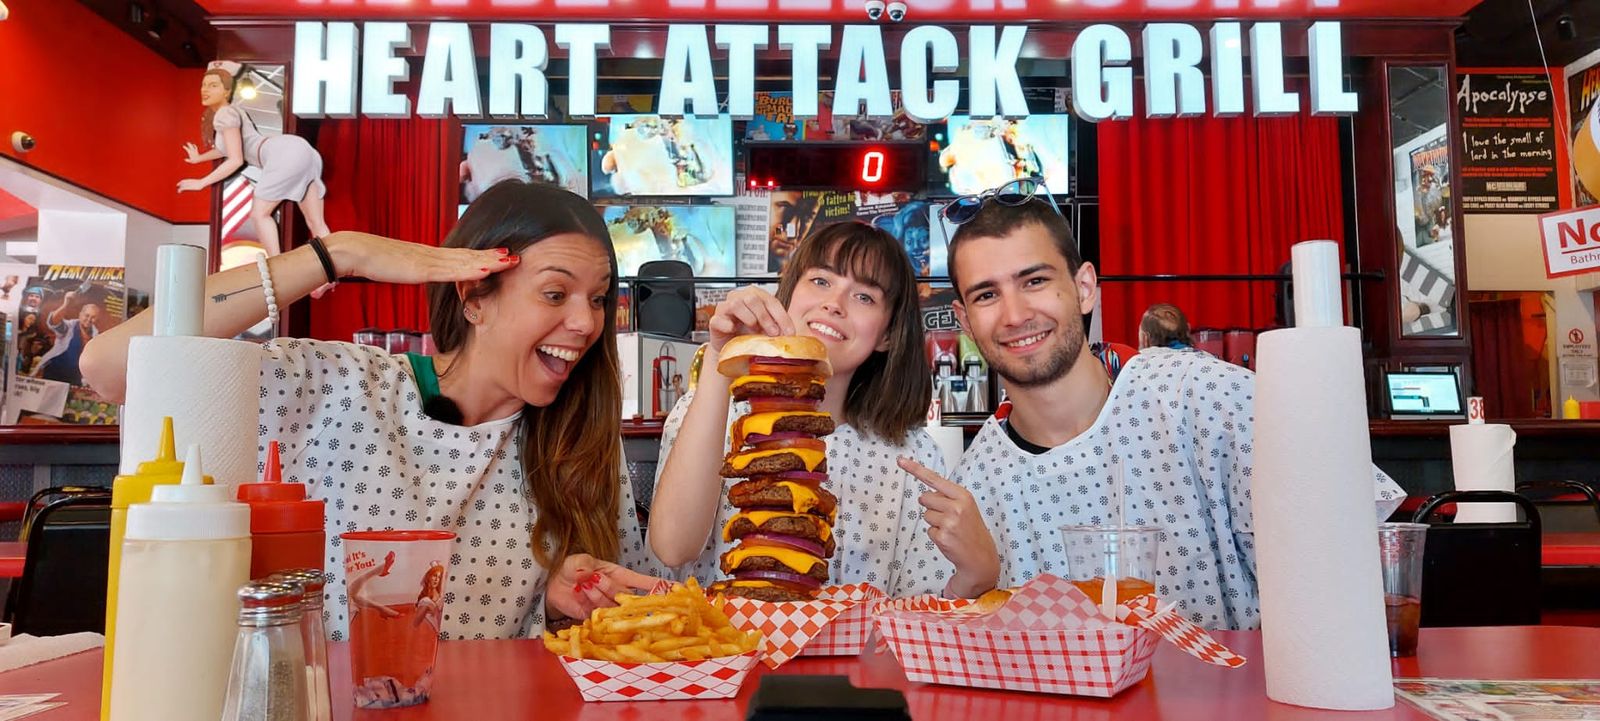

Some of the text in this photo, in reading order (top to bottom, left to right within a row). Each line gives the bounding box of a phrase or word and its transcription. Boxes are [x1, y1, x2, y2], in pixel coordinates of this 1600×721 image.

[292, 21, 1358, 121] HEART ATTACK GRILL
[1457, 74, 1547, 114] Apocalypse
[1493, 132, 1507, 146] the
[1510, 131, 1532, 146] smell
[1535, 131, 1545, 144] of
[1491, 151, 1499, 160] in
[1502, 146, 1516, 159] the
[1520, 148, 1553, 160] morning
[862, 151, 884, 182] 0
[351, 551, 367, 562] It's
[354, 558, 376, 571] You!
